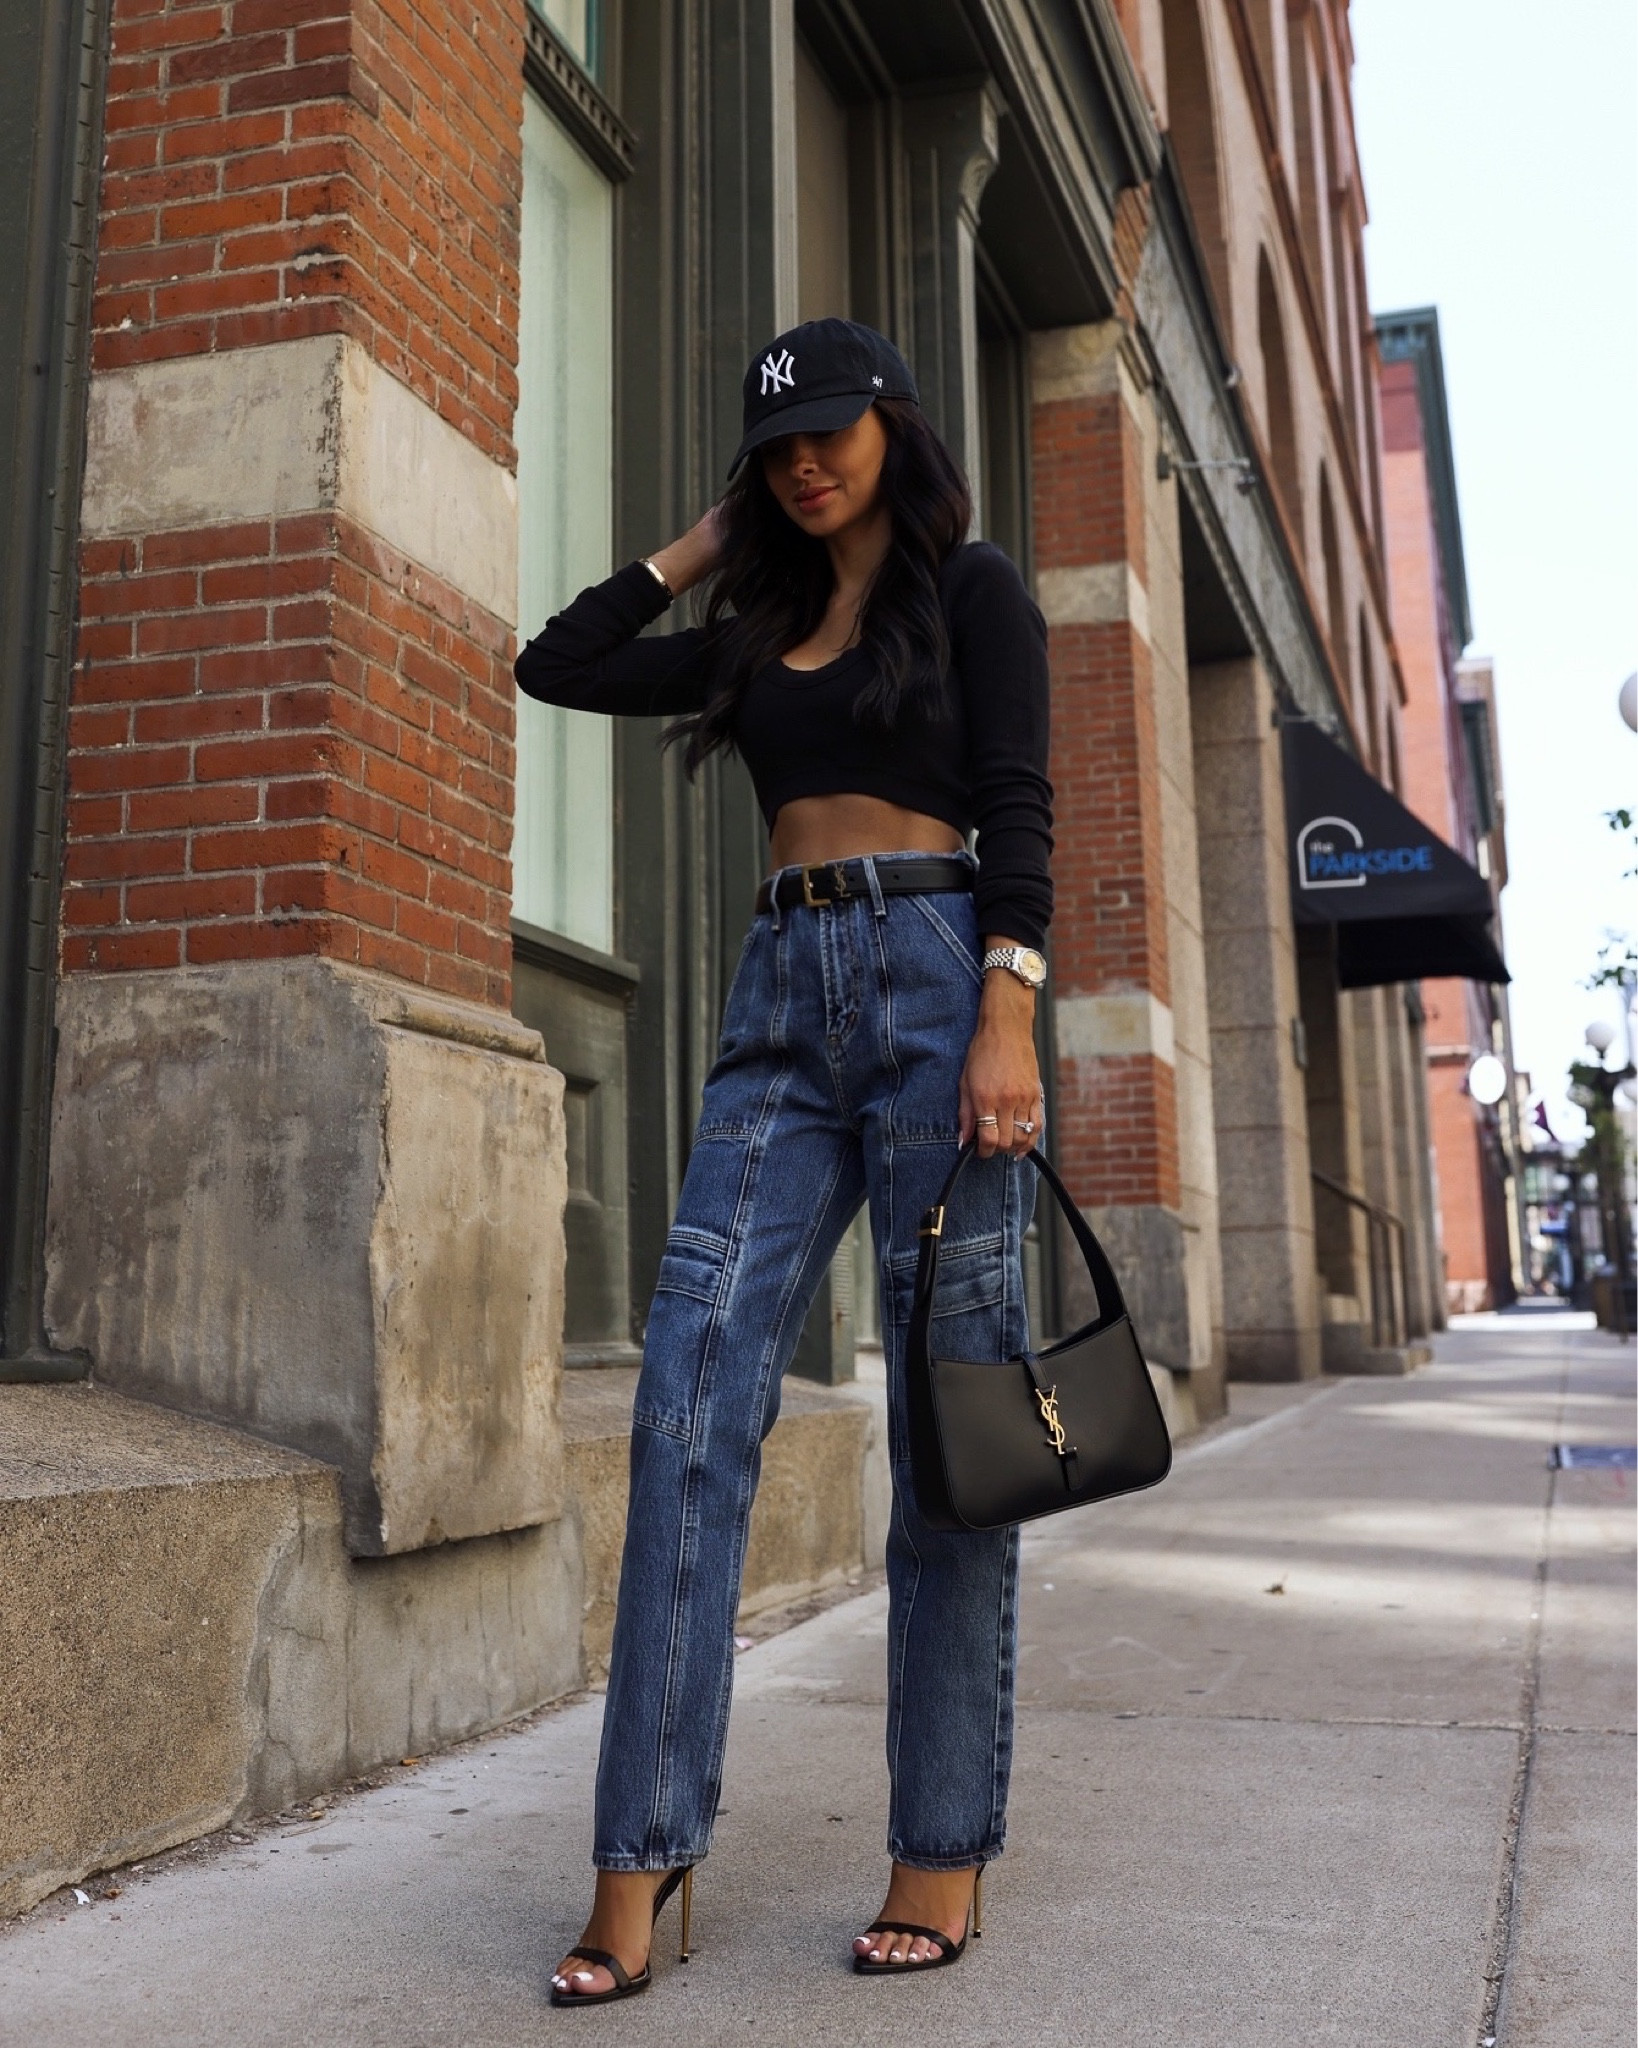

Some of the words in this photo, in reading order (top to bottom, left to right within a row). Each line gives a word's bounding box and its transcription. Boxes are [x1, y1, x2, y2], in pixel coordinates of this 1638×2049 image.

[760, 348, 795, 395] NY
[1309, 839, 1335, 853] the
[1309, 846, 1434, 877] PARKSIDE
[1035, 1384, 1065, 1455] YSL
